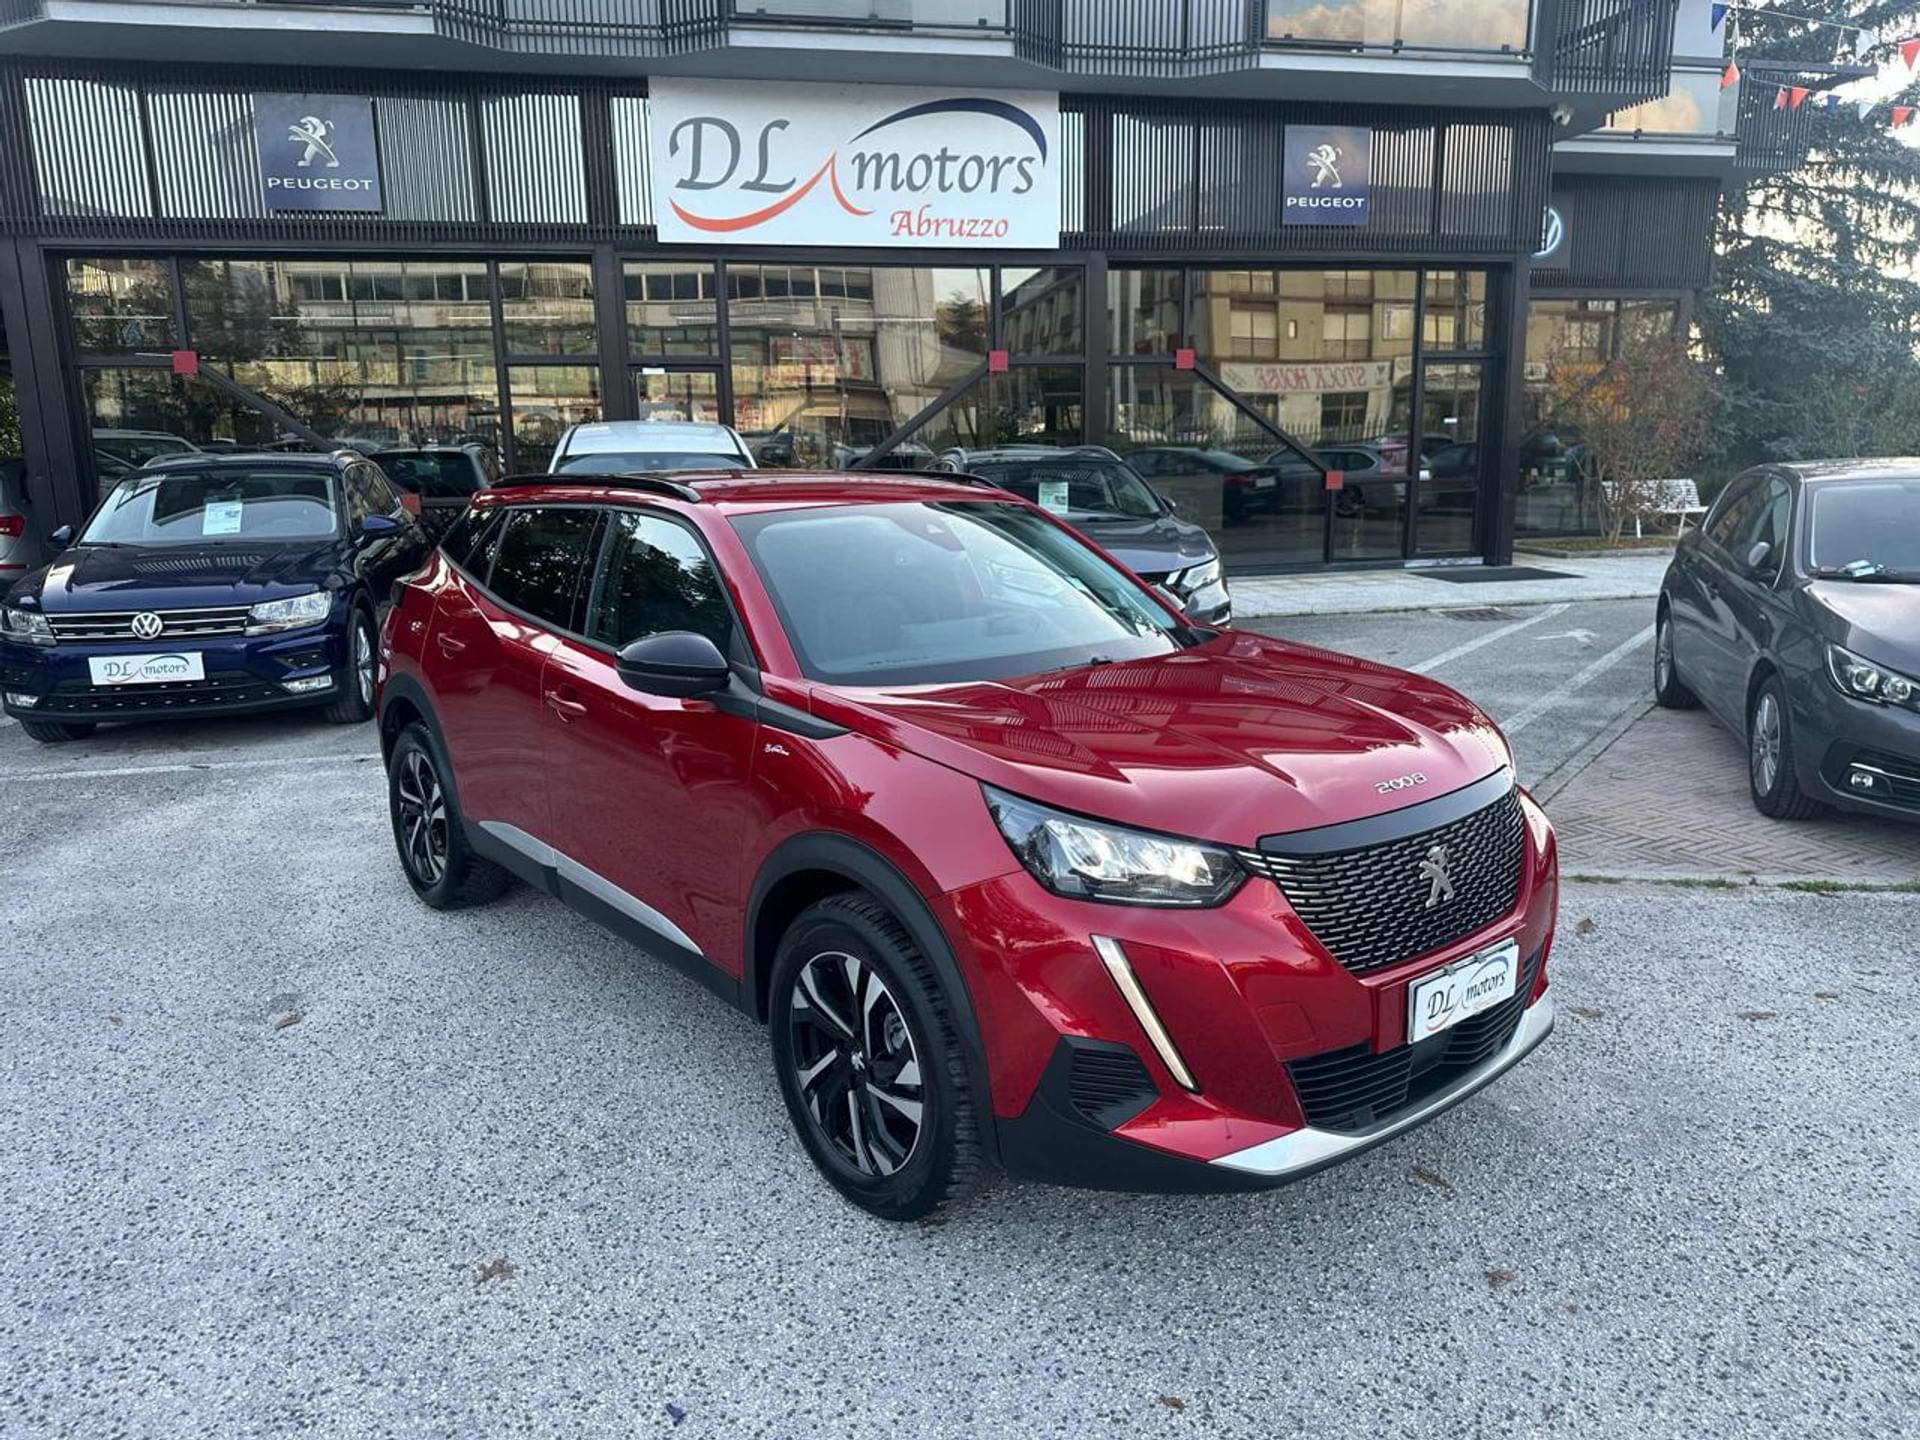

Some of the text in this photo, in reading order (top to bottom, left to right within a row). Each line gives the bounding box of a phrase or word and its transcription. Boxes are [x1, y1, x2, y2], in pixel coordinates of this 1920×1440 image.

[668, 116, 1036, 195] DL motors
[267, 177, 373, 190] PEUGEOT
[1286, 197, 1365, 208] PEUGEOT
[890, 204, 1009, 238] Abruzzo
[104, 661, 188, 677] DL motors
[1374, 772, 1427, 794] 2008
[1428, 984, 1455, 1020] DL
[1465, 971, 1506, 1001] motors
